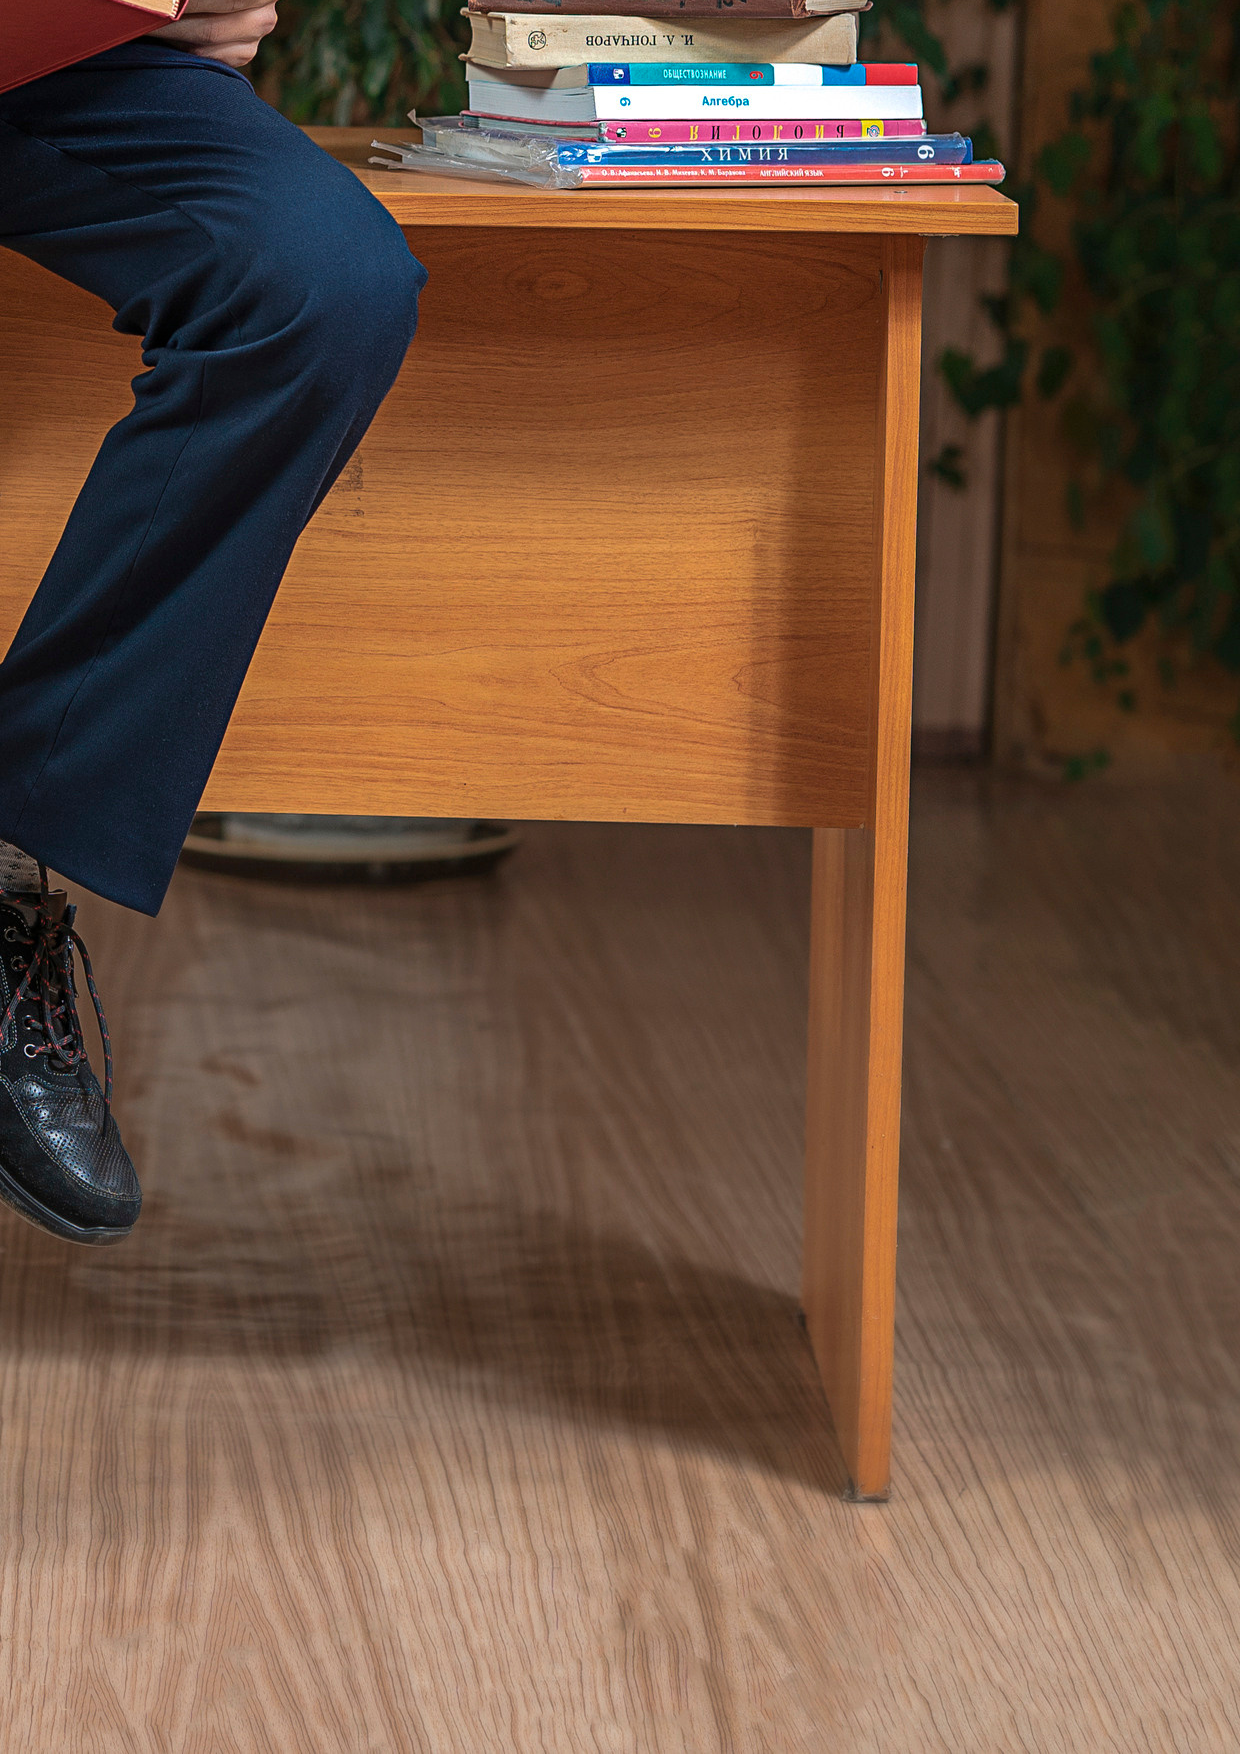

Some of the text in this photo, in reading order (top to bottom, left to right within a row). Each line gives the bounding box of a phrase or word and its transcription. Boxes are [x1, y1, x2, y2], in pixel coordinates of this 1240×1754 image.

[586, 34, 657, 46] ГОНЧАРОВ
[663, 69, 727, 81] ОБЩЕСТВОЗНАНИЕ
[701, 96, 750, 108] Алгебра
[689, 124, 845, 140] БИОЛОГИЯ
[700, 147, 788, 161] ХИМИЯ
[759, 168, 804, 177] АНГЛИЙСКИЙ
[804, 169, 824, 177] ЯЗЫК
